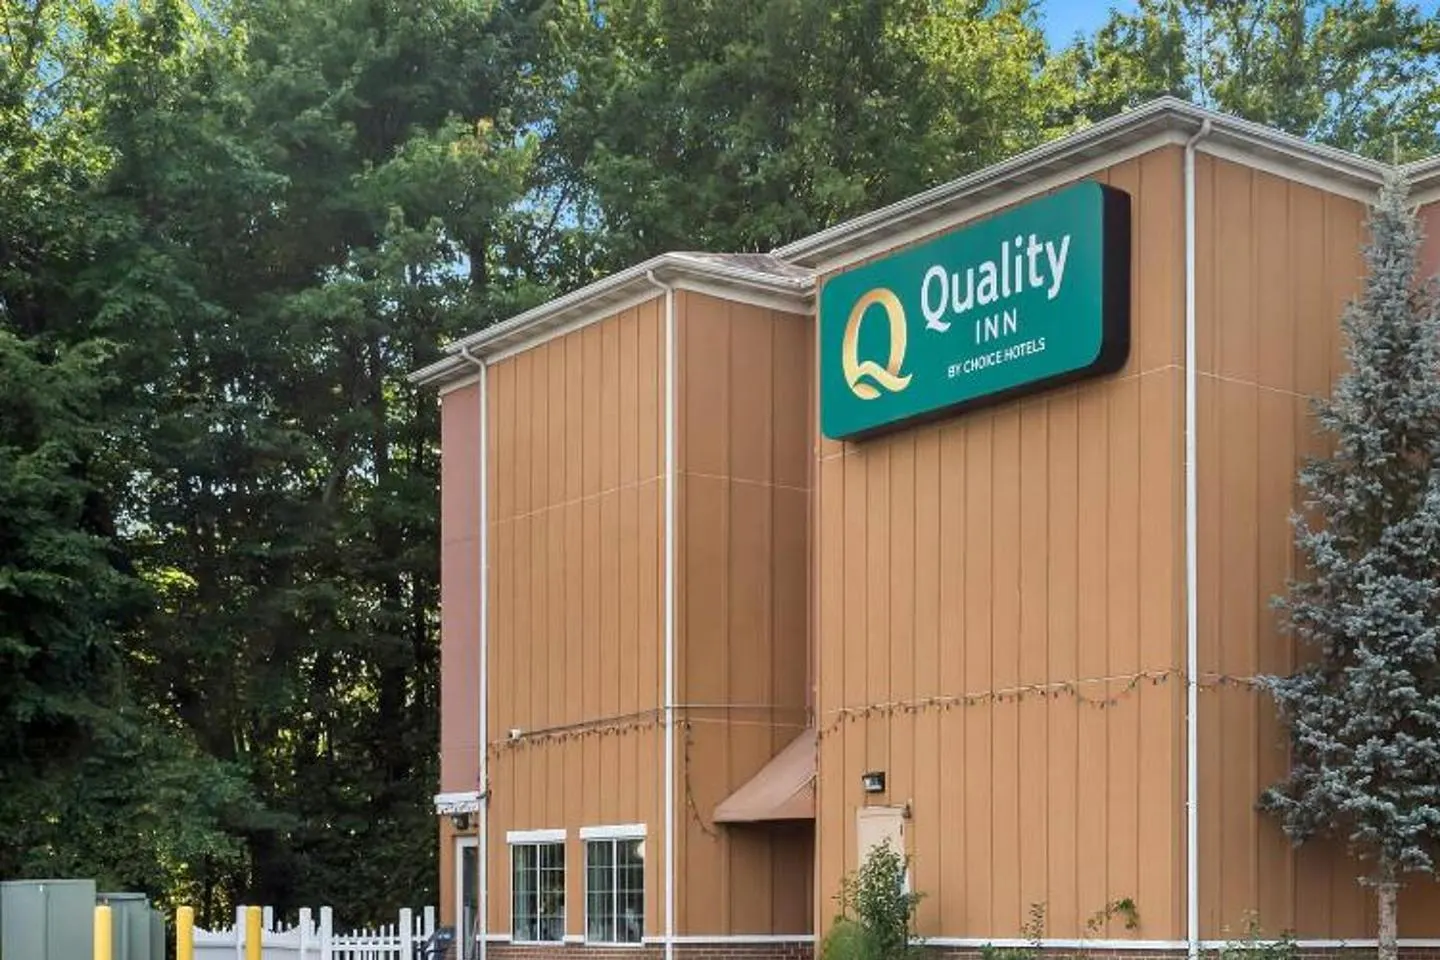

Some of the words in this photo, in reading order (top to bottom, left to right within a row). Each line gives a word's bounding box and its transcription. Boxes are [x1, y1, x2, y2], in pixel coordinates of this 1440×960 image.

[920, 233, 1071, 332] Quality
[842, 288, 913, 400] Q
[948, 363, 962, 379] BY
[963, 350, 1003, 374] CHOICE
[1004, 336, 1046, 362] HOTELS
[976, 308, 1018, 344] INN
